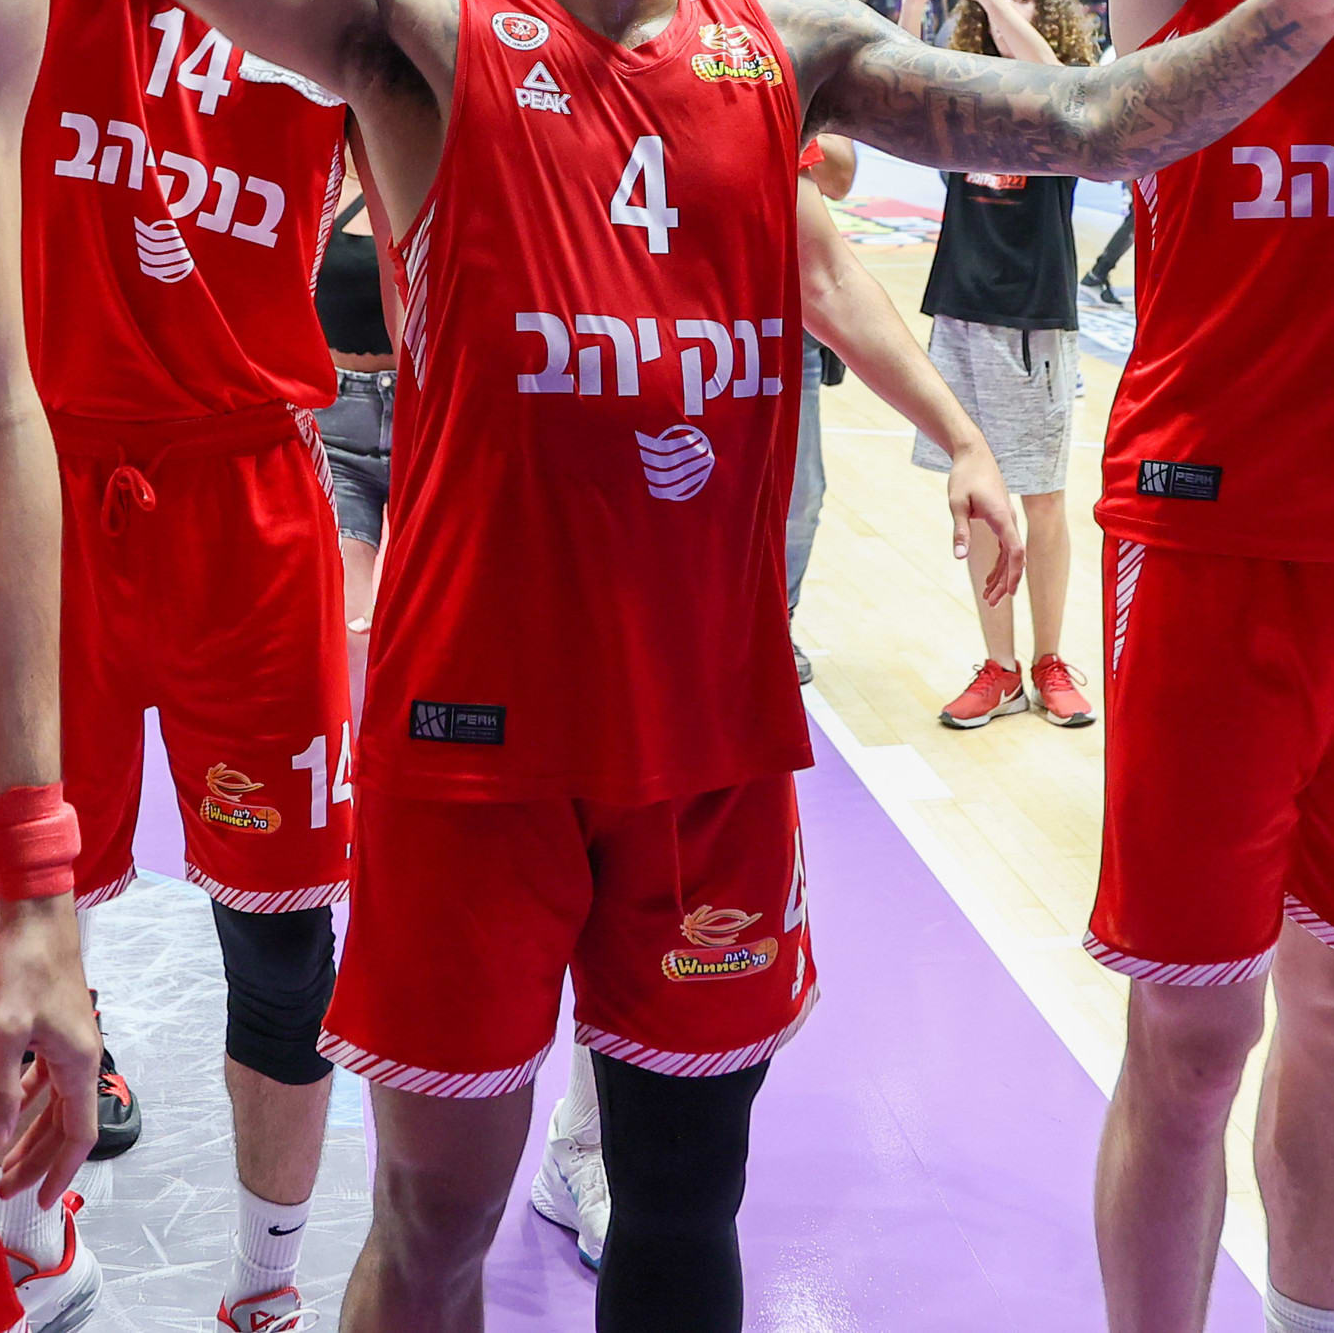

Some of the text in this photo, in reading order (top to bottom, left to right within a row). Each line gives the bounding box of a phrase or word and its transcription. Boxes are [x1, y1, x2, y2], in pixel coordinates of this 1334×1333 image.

[145, 7, 234, 116] 14
[704, 61, 764, 78] Winner
[514, 87, 571, 115] PEAK
[157, 150, 286, 248] בנק
[610, 135, 679, 254] 4
[515, 311, 662, 397] יהב
[456, 714, 497, 726] PEAK
[208, 803, 252, 828] Winner
[253, 817, 267, 829] סל
[676, 957, 750, 975] Winner
[752, 954, 767, 966] סל
